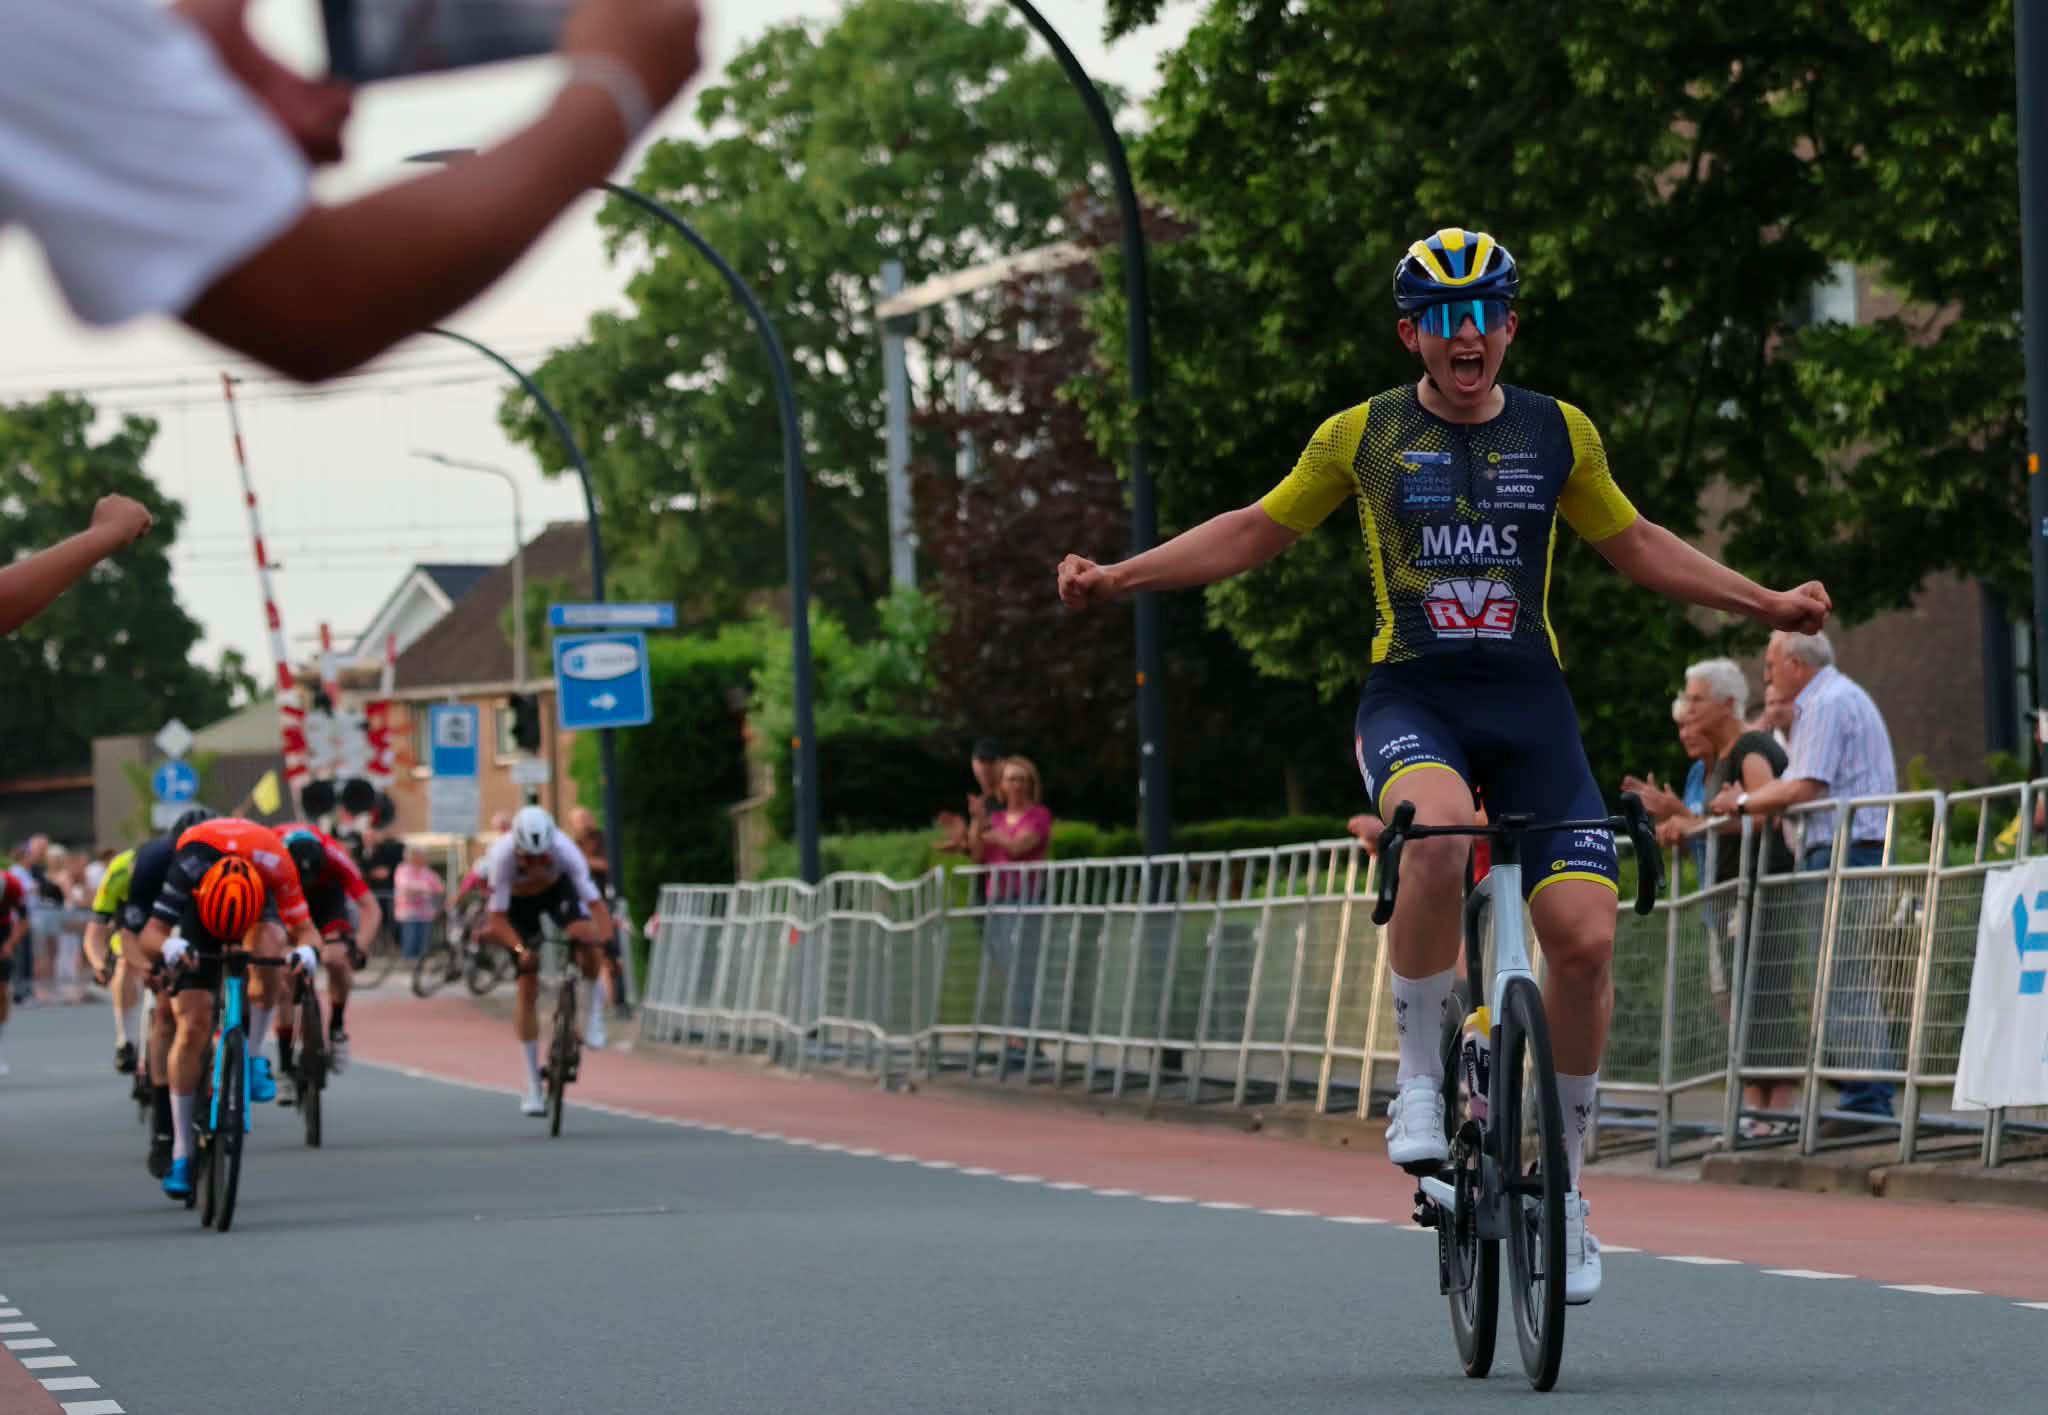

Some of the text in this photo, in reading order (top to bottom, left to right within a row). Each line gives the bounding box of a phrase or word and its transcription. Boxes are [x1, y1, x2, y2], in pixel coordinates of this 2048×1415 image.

[1495, 484, 1536, 494] SAKKO
[1422, 523, 1520, 557] MAAS
[1459, 554, 1471, 566] &
[1566, 860, 1608, 871] ROGELLI
